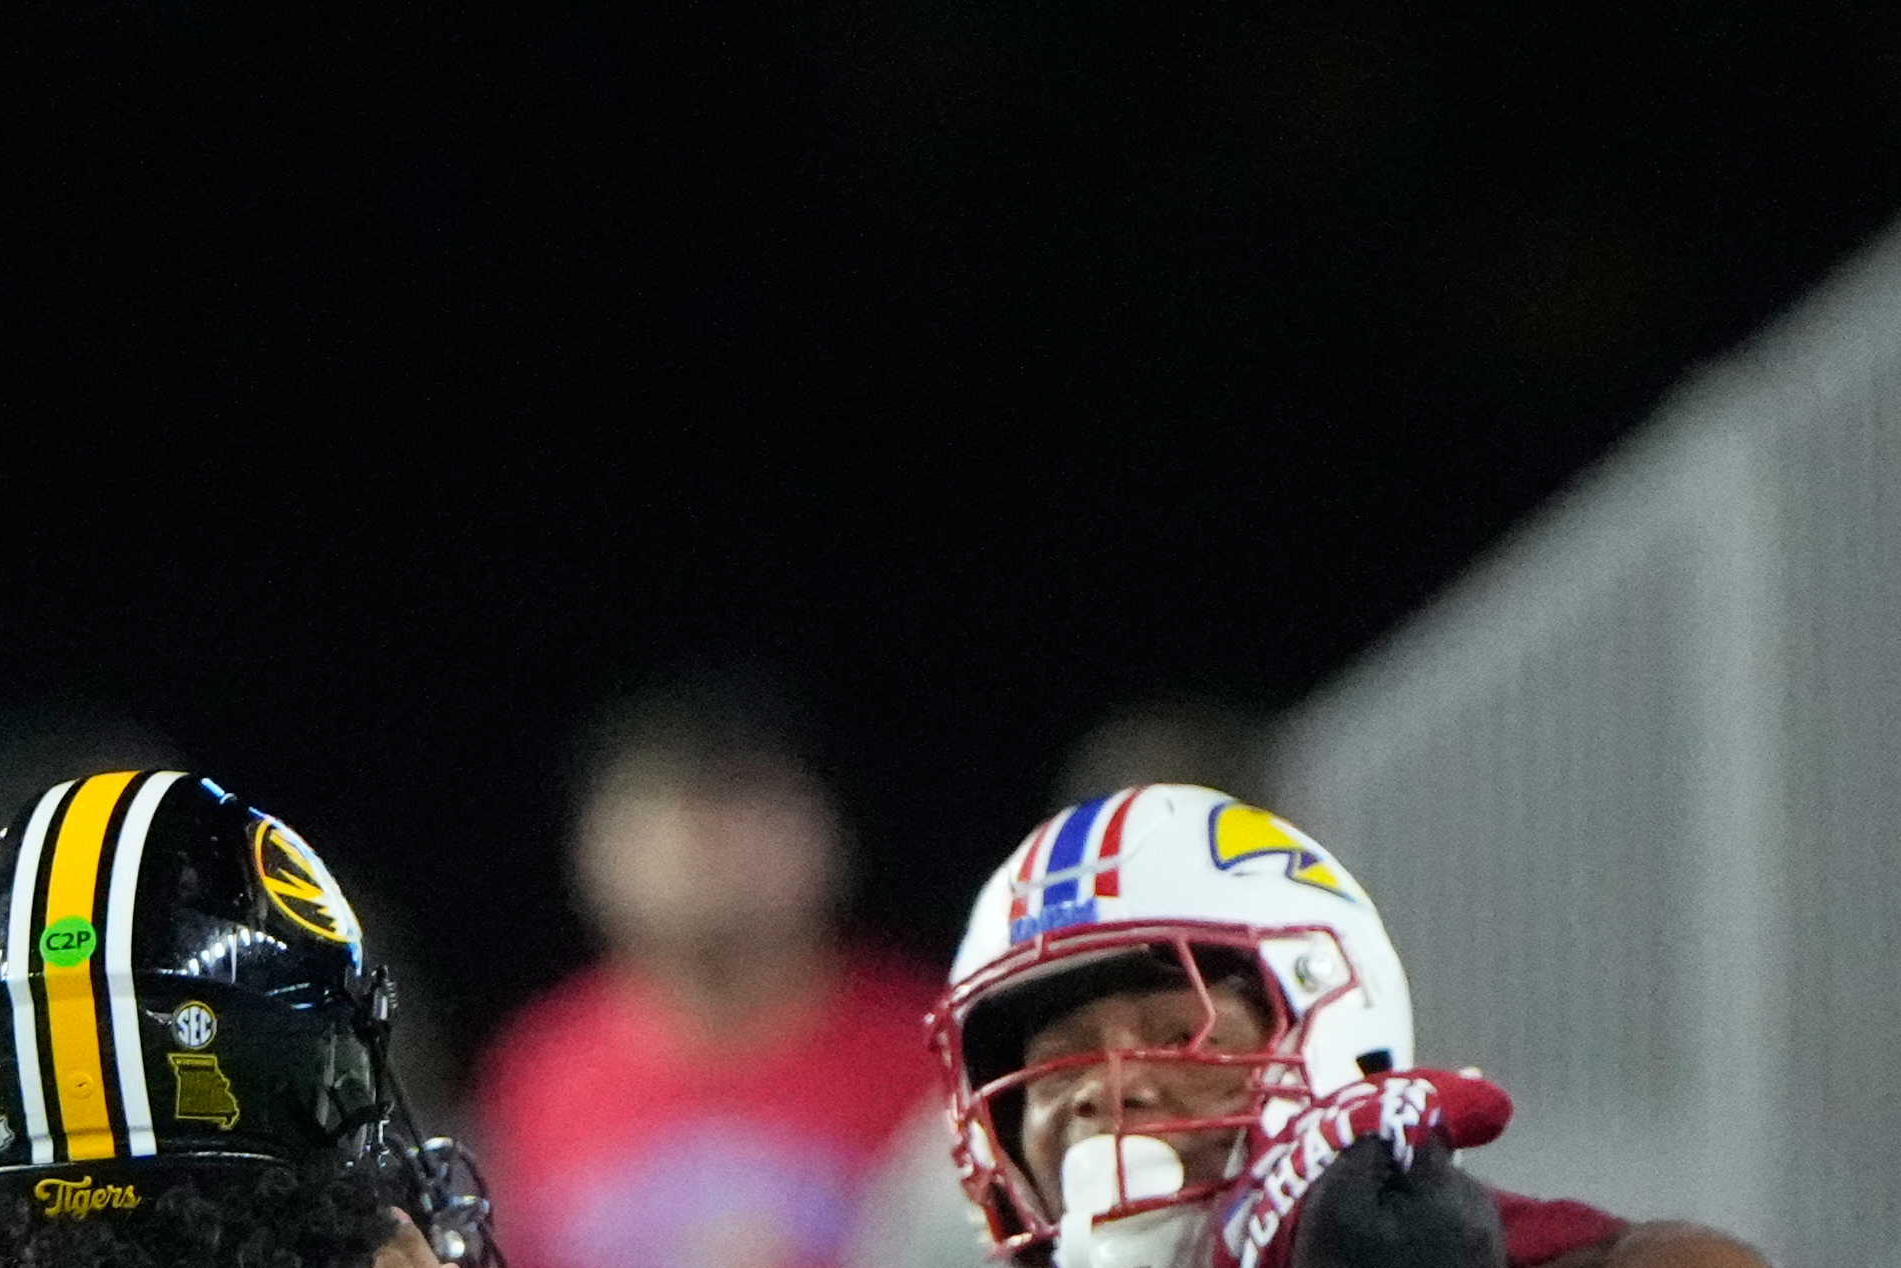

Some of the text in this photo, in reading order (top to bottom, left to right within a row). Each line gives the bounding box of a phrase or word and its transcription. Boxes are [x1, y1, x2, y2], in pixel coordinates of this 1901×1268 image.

[45, 931, 91, 951] C2P
[176, 1004, 212, 1047] SEC
[35, 1175, 142, 1219] Tigers
